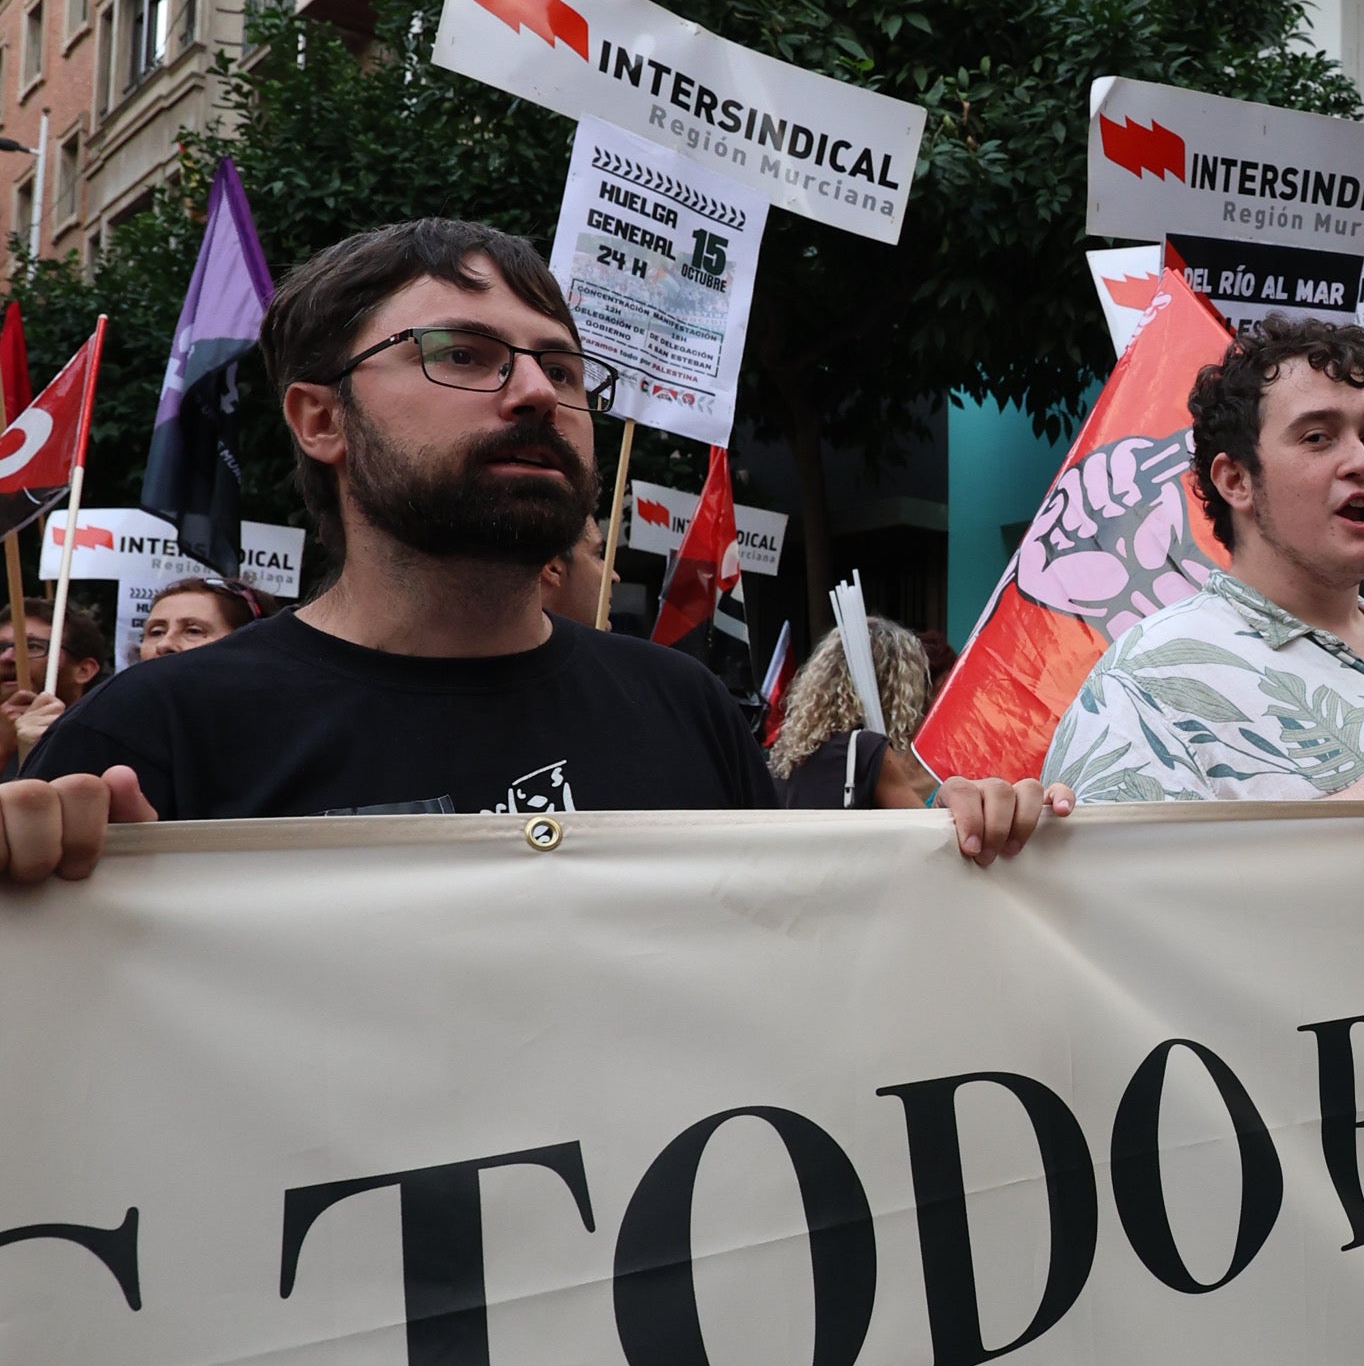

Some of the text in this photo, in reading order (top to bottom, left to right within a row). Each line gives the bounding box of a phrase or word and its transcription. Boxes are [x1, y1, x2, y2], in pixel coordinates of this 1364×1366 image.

[599, 40, 899, 190] INTERSINDICAL
[649, 104, 894, 216] Región Murciana
[599, 181, 679, 229] HUELGA
[1223, 201, 1303, 230] Región
[587, 208, 677, 261] GENERAL
[692, 228, 729, 277] 15
[597, 245, 648, 279] 24 H
[681, 263, 728, 294] OCTUBRE
[577, 286, 650, 316] CONCENTRACIÓN
[1184, 267, 1212, 294] DEL
[1219, 265, 1255, 298] RÍO
[1261, 275, 1288, 300] AL
[1295, 278, 1345, 306] MAR
[586, 320, 632, 341] GOBIERNO
[652, 313, 718, 342] MANIFESTACIÓN
